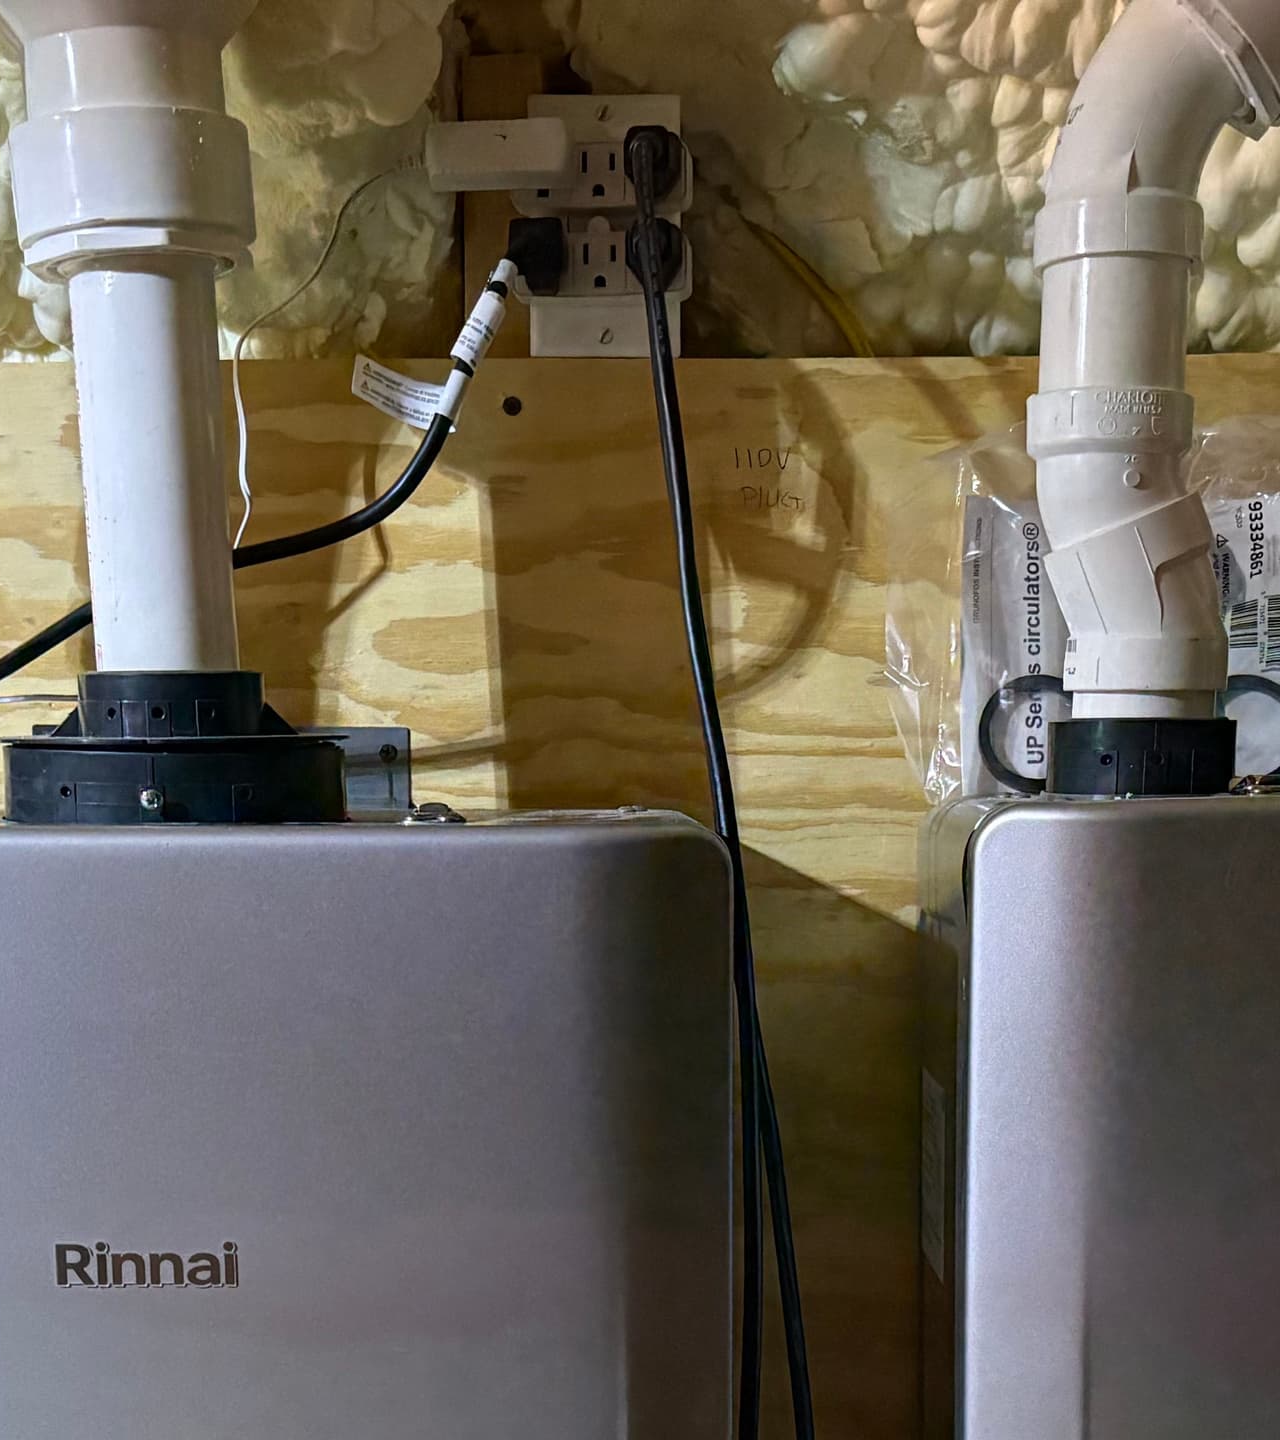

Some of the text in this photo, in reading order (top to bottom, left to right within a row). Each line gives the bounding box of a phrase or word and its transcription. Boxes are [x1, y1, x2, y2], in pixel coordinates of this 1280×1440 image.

[1248, 501, 1264, 579] 93334861
[1026, 735, 1044, 764] UP
[54, 1241, 238, 1287] Rinnai
